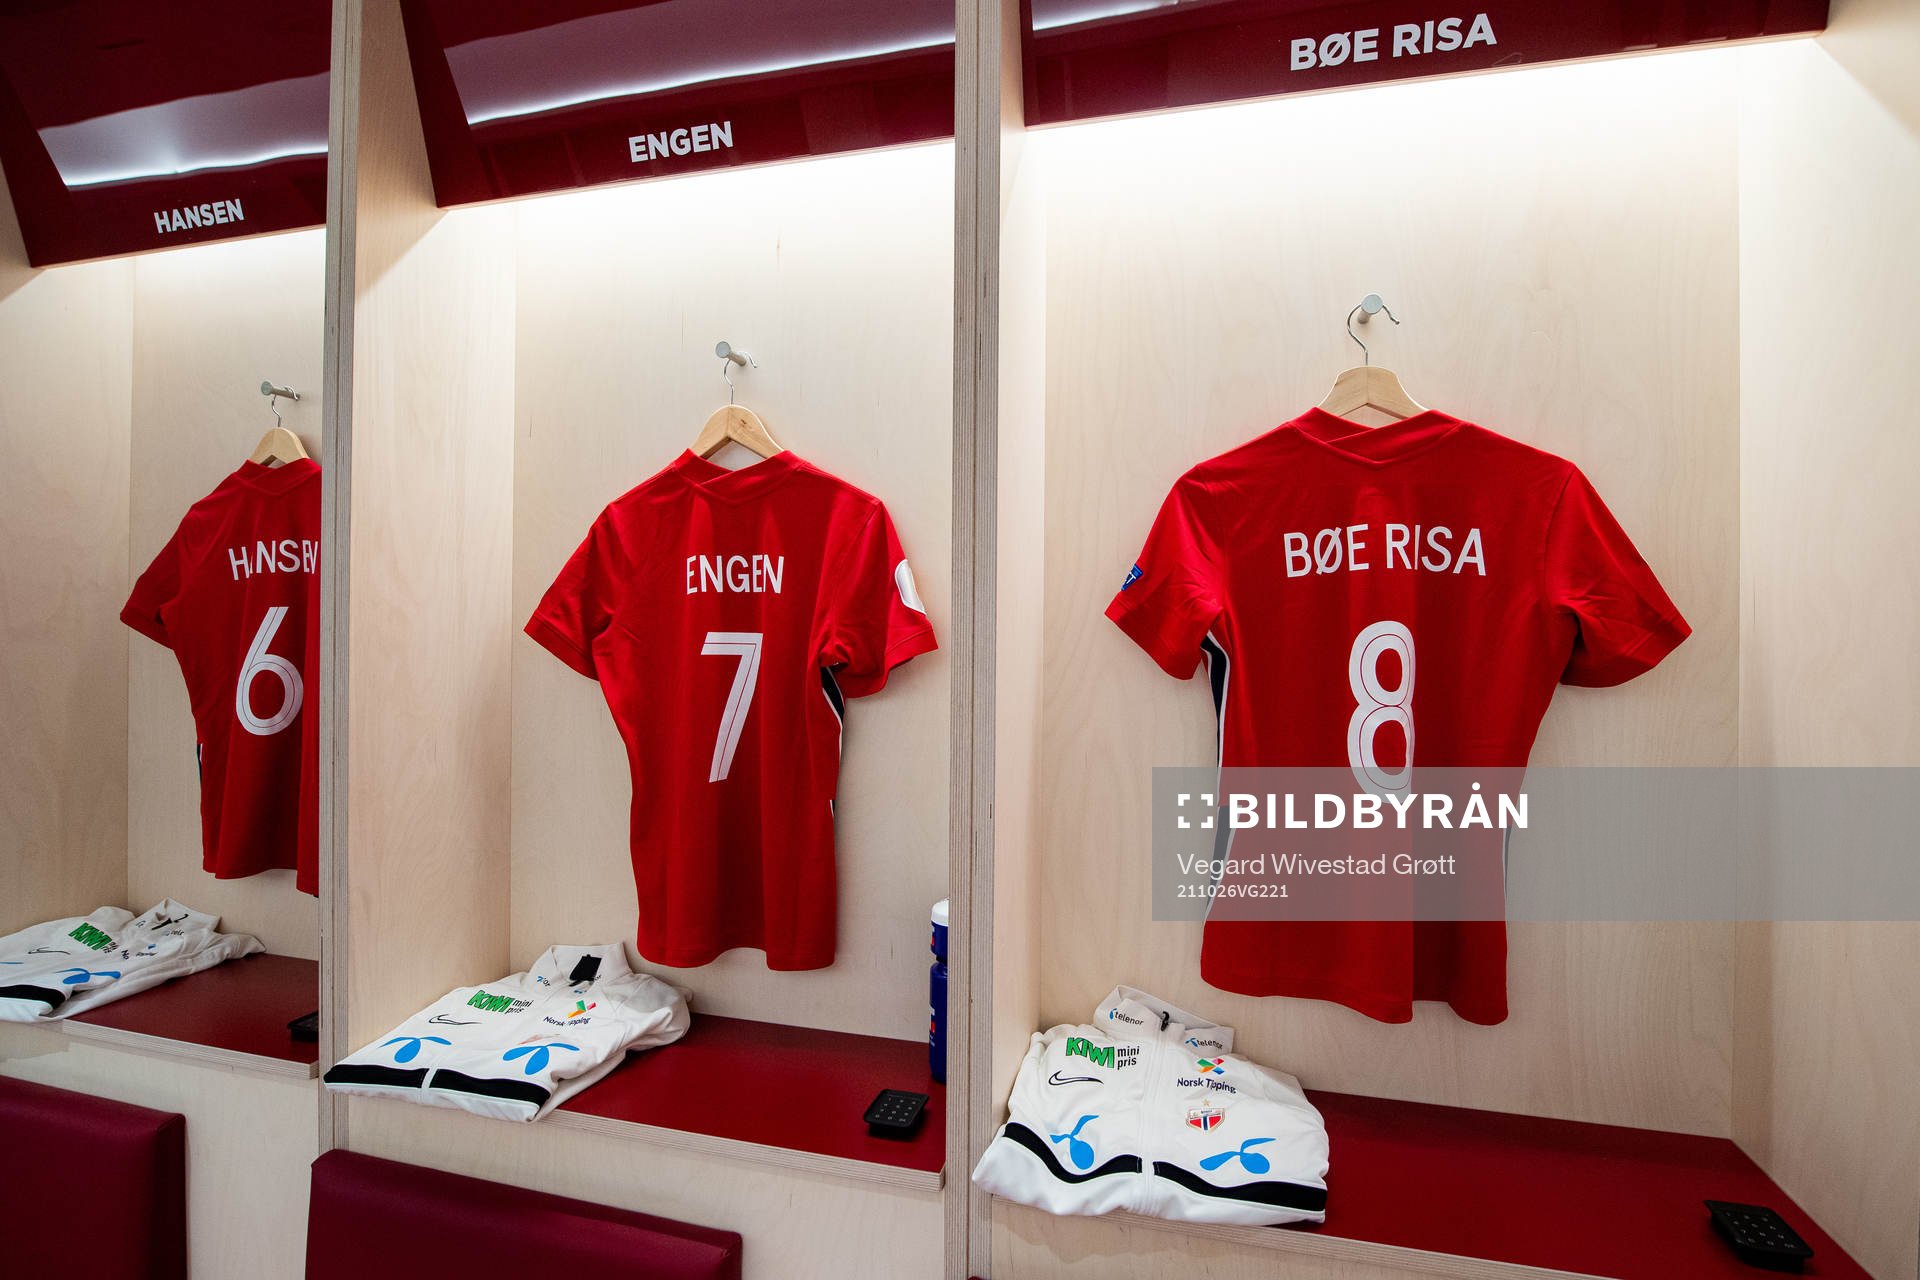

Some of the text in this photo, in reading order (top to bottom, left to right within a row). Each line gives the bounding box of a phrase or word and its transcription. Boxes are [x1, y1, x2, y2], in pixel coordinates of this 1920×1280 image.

[1290, 13, 1498, 71] BØE RISA
[628, 121, 734, 163] ENGEN
[153, 198, 245, 234] HANSEN
[228, 539, 319, 581] HNSEN
[1283, 523, 1487, 578] BØE RISA
[686, 554, 785, 595] ENGEN
[235, 606, 304, 736] 6
[700, 631, 764, 783] 7
[1347, 620, 1416, 804] 8
[466, 990, 515, 1013] KIWI
[1115, 1011, 1144, 1025] telenor
[1065, 1036, 1115, 1068] KIWI
[1117, 1046, 1140, 1057] mini
[1117, 1057, 1137, 1070] pris
[1177, 1077, 1204, 1087] Norsk
